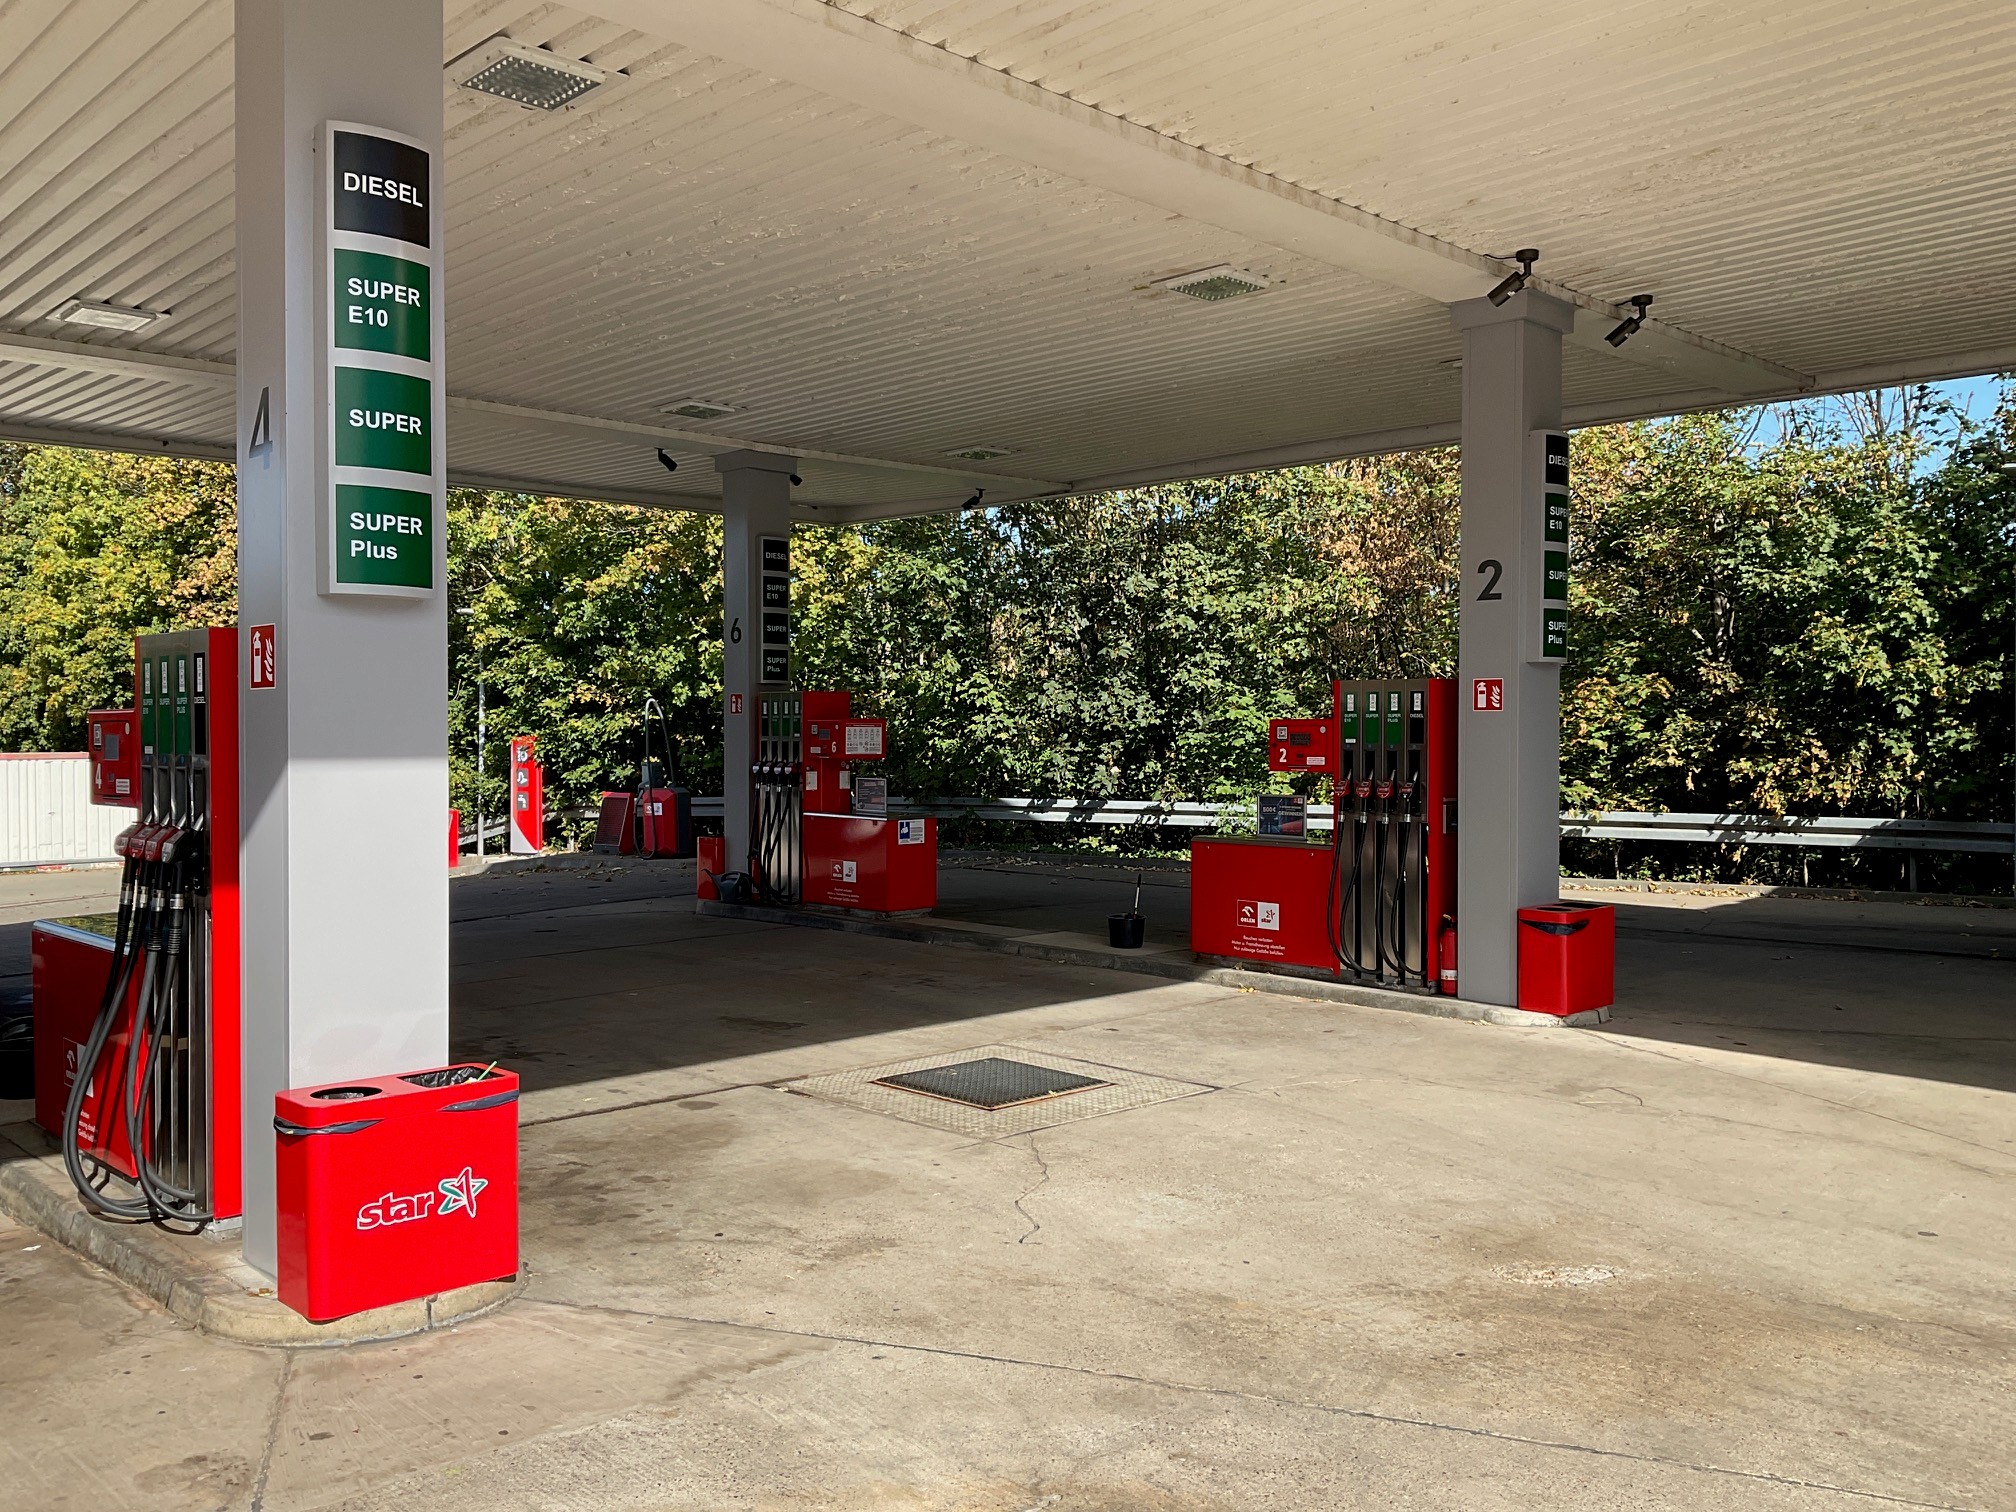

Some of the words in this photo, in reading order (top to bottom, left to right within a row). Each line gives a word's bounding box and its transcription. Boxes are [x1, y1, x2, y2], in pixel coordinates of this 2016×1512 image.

[343, 172, 423, 208] DIESEL
[347, 277, 421, 307] SUPER
[348, 305, 389, 327] E10
[249, 386, 273, 470] 4
[349, 409, 422, 435] SUPER
[1549, 455, 1568, 467] DIESE
[350, 512, 423, 536] SUPER
[1550, 520, 1563, 530] E10
[350, 539, 398, 560] Plus
[765, 552, 787, 560] DIESEL
[1476, 559, 1503, 601] 2
[1549, 570, 1567, 581] SUPE
[767, 584, 787, 592] SUPER
[730, 618, 742, 644] 6
[1548, 621, 1567, 631] SUPE
[1548, 635, 1563, 645] Plus
[831, 741, 837, 753] 6
[1279, 748, 1287, 763] 2
[95, 763, 102, 789] 4
[357, 1191, 434, 1230] star
